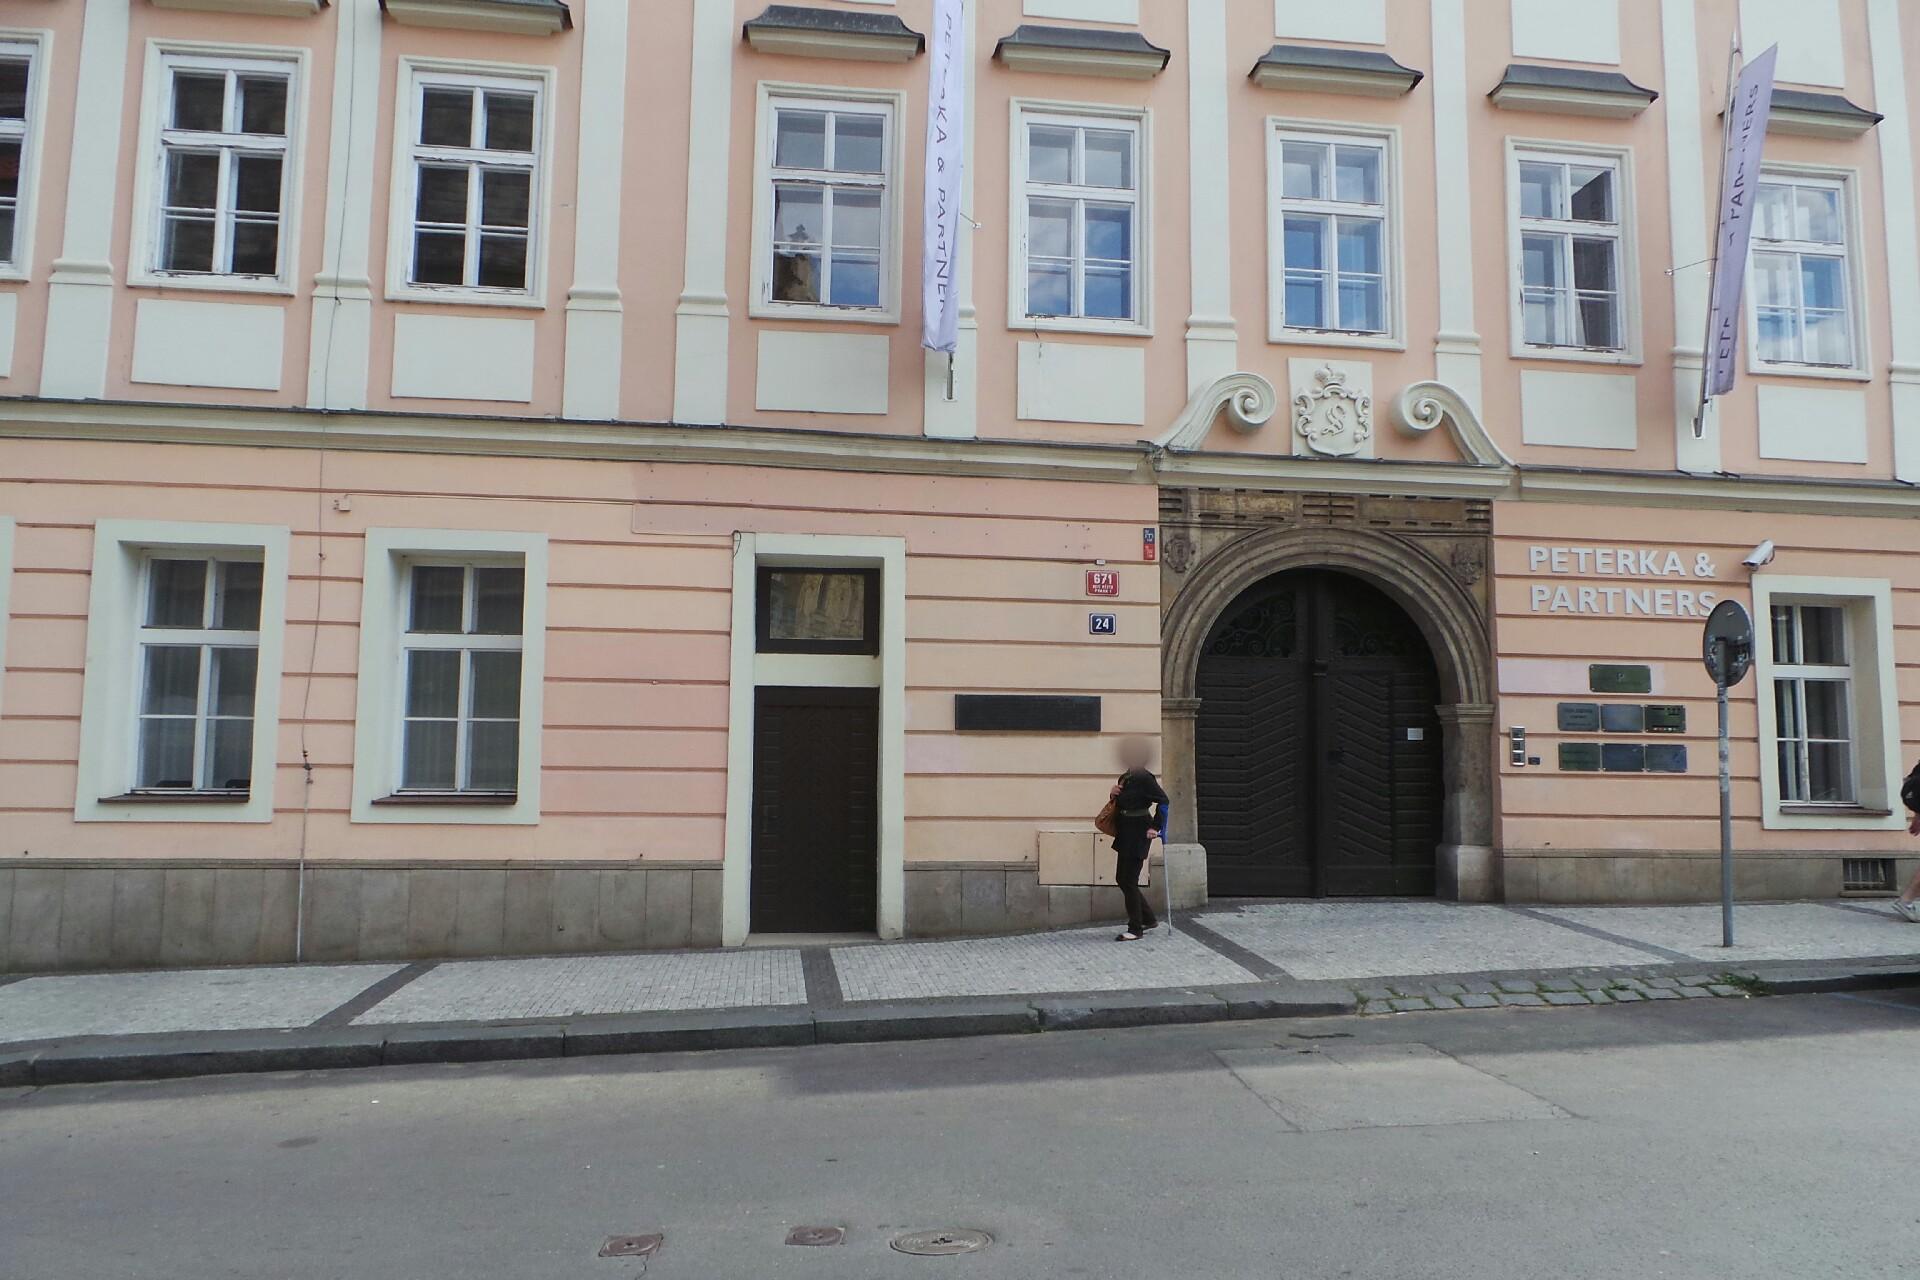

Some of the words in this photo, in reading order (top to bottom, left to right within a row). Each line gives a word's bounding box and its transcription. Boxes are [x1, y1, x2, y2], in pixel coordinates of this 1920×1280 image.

[1529, 546, 1687, 576] PETERKA
[1694, 552, 1716, 577] &
[1094, 573, 1112, 584] 671
[1531, 584, 1716, 617] PARTNERS
[1095, 618, 1109, 630] 24
